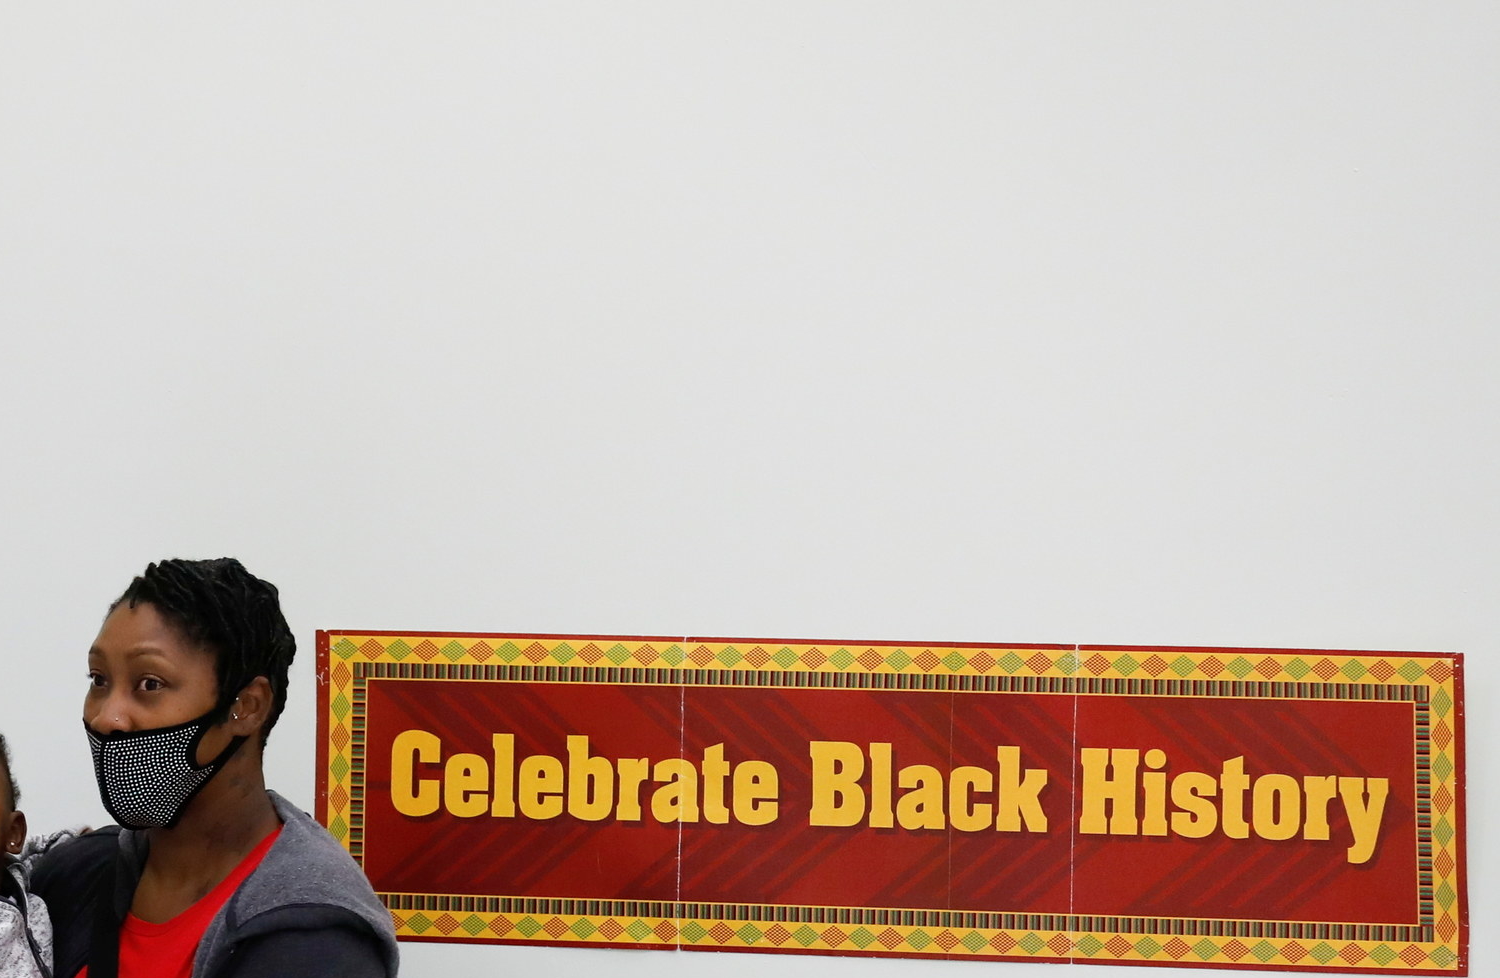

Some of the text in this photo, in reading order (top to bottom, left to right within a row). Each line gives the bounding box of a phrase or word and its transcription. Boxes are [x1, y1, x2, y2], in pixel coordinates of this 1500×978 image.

[389, 729, 1389, 864] Celebrate Black History
